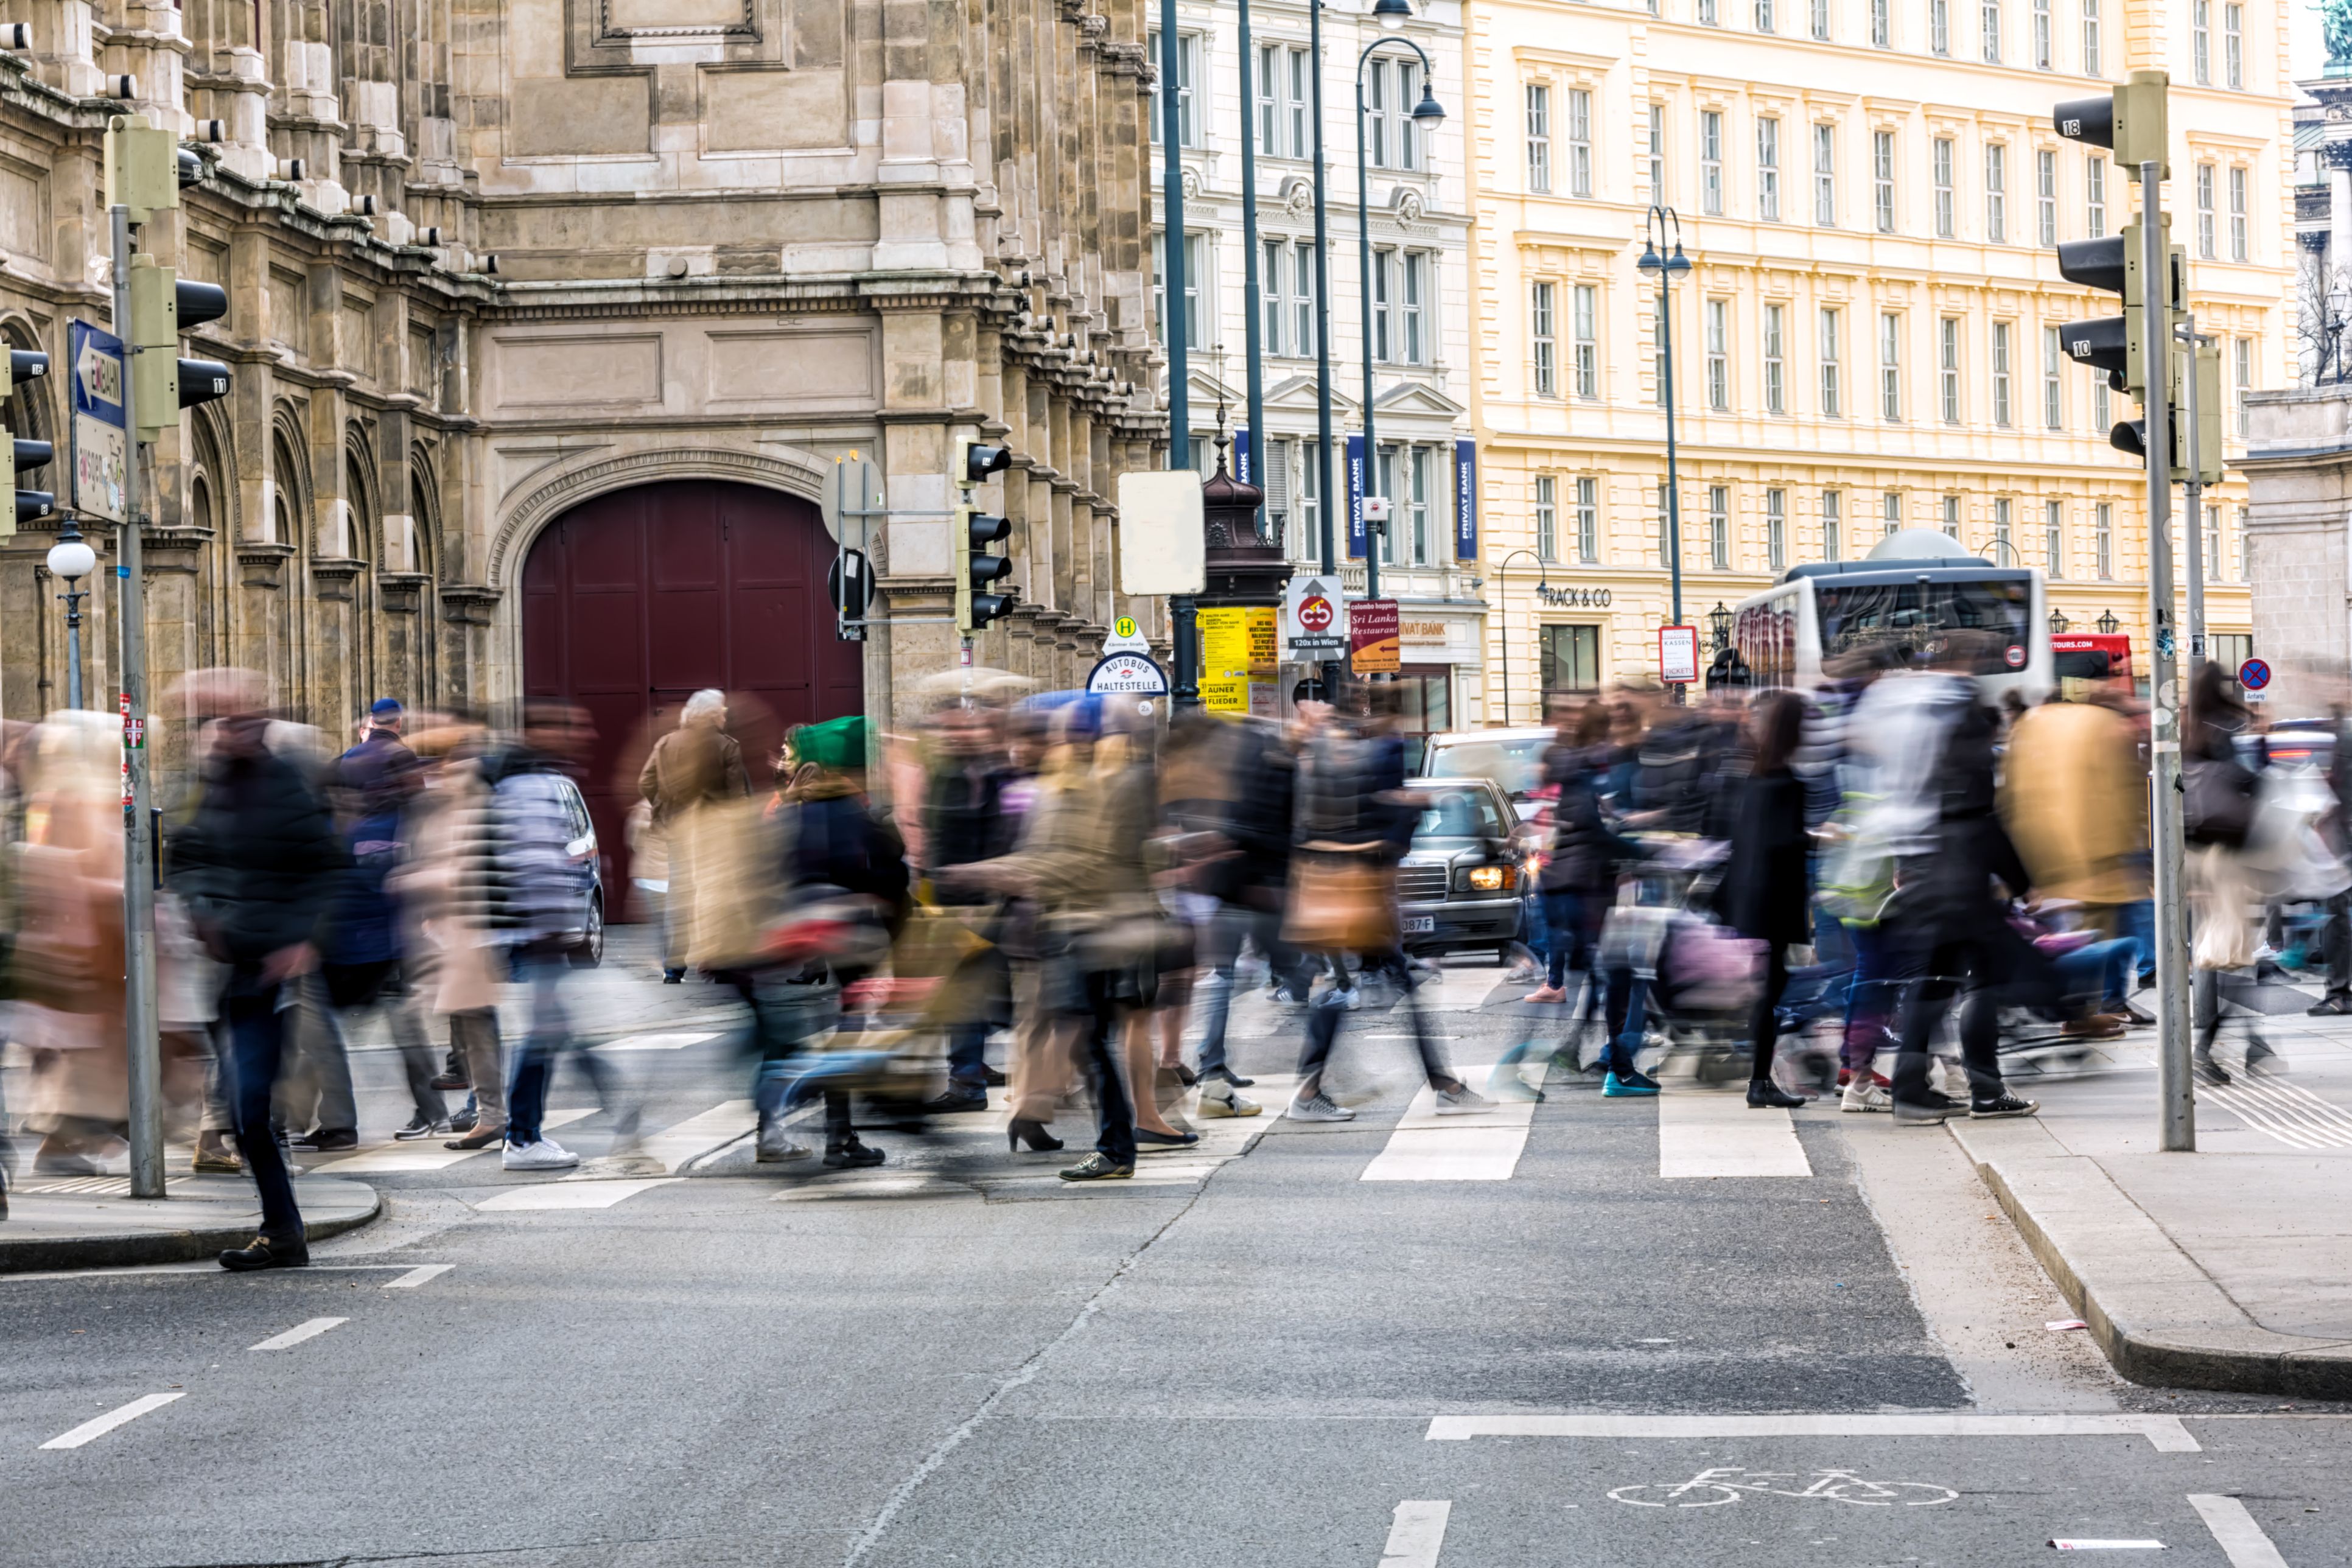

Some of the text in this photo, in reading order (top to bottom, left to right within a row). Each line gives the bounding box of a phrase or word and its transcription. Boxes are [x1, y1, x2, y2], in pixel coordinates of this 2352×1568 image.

[2065, 121, 2079, 135] 18
[194, 165, 202, 179] 19
[2075, 341, 2090, 355] 10
[33, 365, 43, 374] 16
[91, 354, 120, 400] EBAHN
[215, 379, 225, 393] 11
[79, 447, 103, 493] asgen
[41, 505, 47, 514] 8
[1544, 587, 1611, 607] FRACK & CO
[1352, 614, 1397, 624] Sri Lanka
[1121, 621, 1131, 634] H
[1399, 623, 1446, 635] RIVAT BANK
[1105, 659, 1150, 674] AUTOBUS
[1097, 681, 1157, 691] HALTESTELLE
[1425, 919, 1432, 929] F
